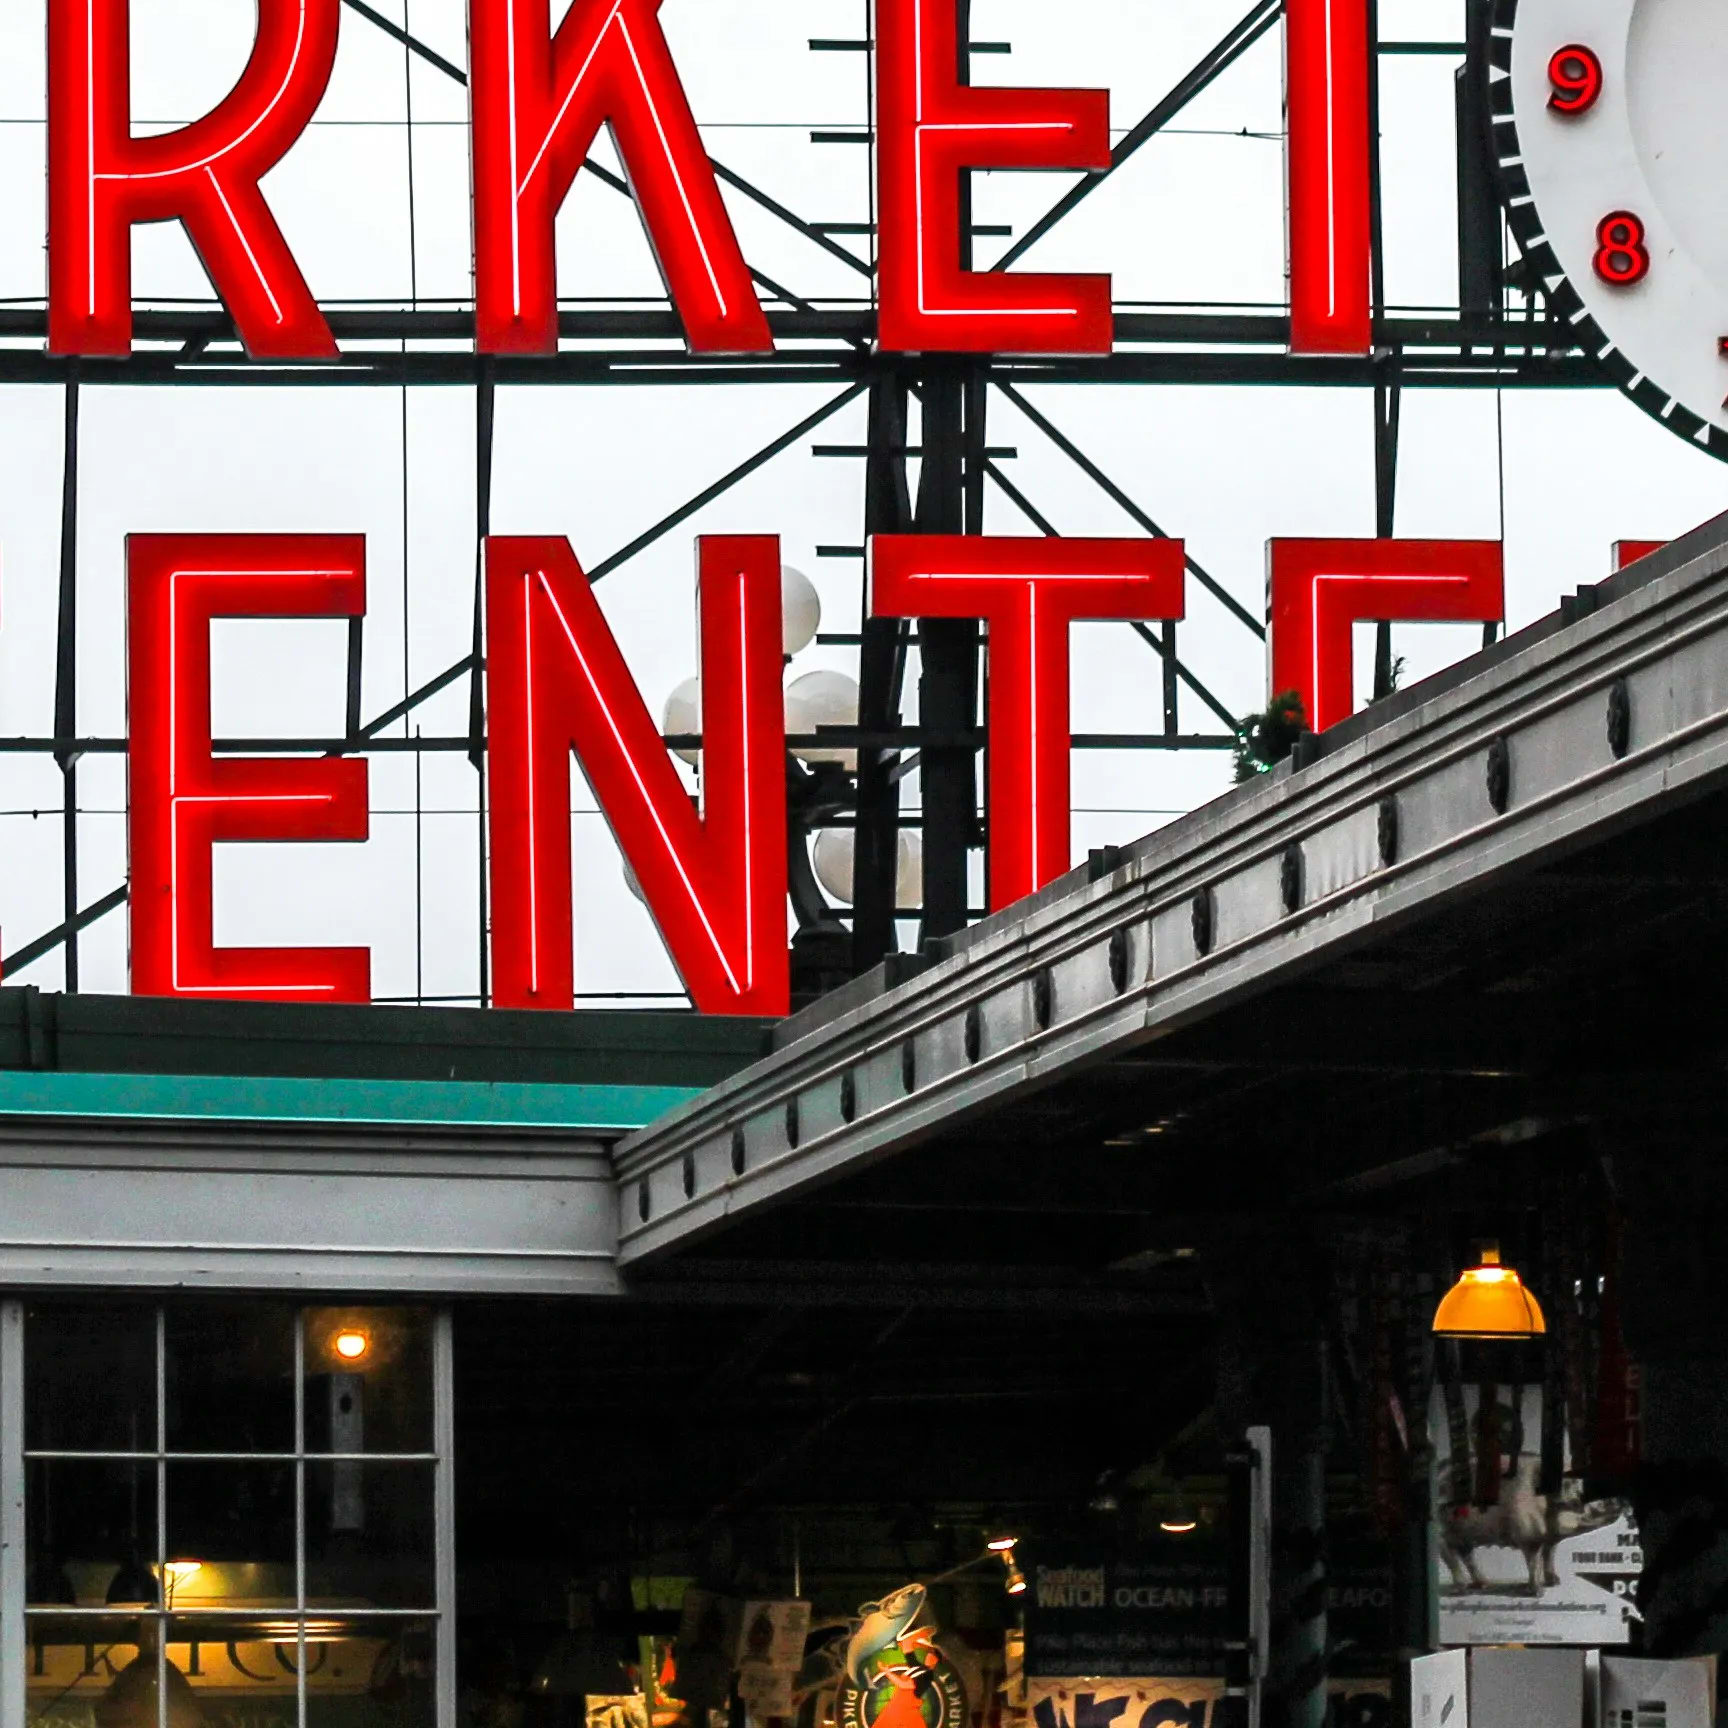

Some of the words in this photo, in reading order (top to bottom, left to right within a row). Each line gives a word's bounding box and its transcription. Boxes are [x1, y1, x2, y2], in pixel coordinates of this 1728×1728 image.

[1546, 43, 1604, 116] 9
[1591, 210, 1651, 286] 8
[1036, 1585, 1105, 1608] WATCH
[938, 1672, 963, 1728] ARKET
